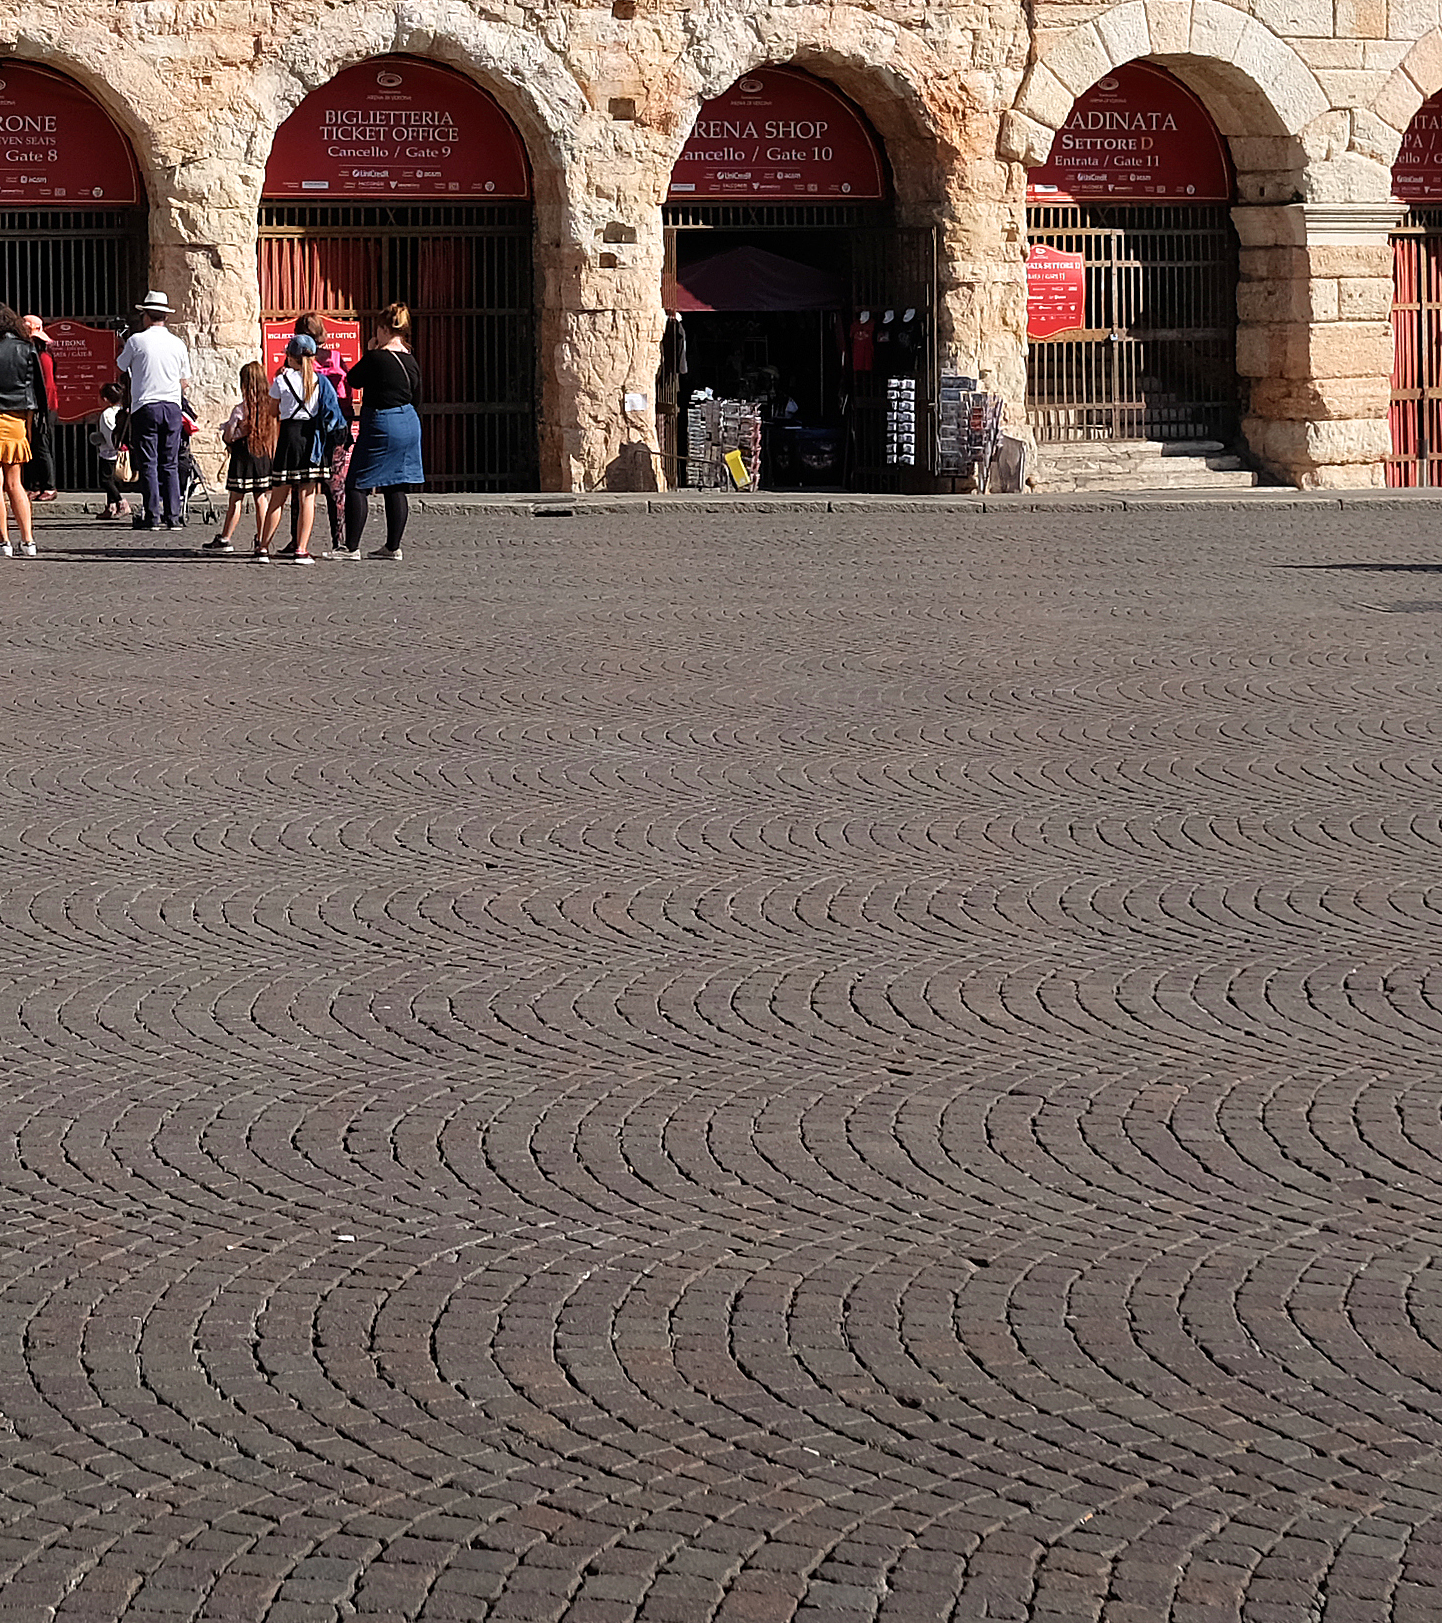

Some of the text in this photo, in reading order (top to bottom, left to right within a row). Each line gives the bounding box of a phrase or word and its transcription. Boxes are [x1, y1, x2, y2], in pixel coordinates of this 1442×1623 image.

[325, 110, 454, 125] BIGLIETTERIA
[320, 126, 459, 142] TICKET OFFICE
[765, 121, 828, 139] SHOP
[25, 136, 56, 146] SEATS
[1141, 137, 1154, 151] D
[5, 149, 43, 162] Gate
[47, 149, 58, 162] 8
[327, 146, 389, 157] Cancello
[405, 146, 439, 157] Gate
[441, 145, 451, 158] 9
[679, 147, 745, 161] ancello
[766, 147, 807, 161] Gate
[811, 146, 833, 161] 10
[1055, 155, 1099, 167] Entrata
[1114, 156, 1143, 167] Gate
[1147, 155, 1160, 167] 11
